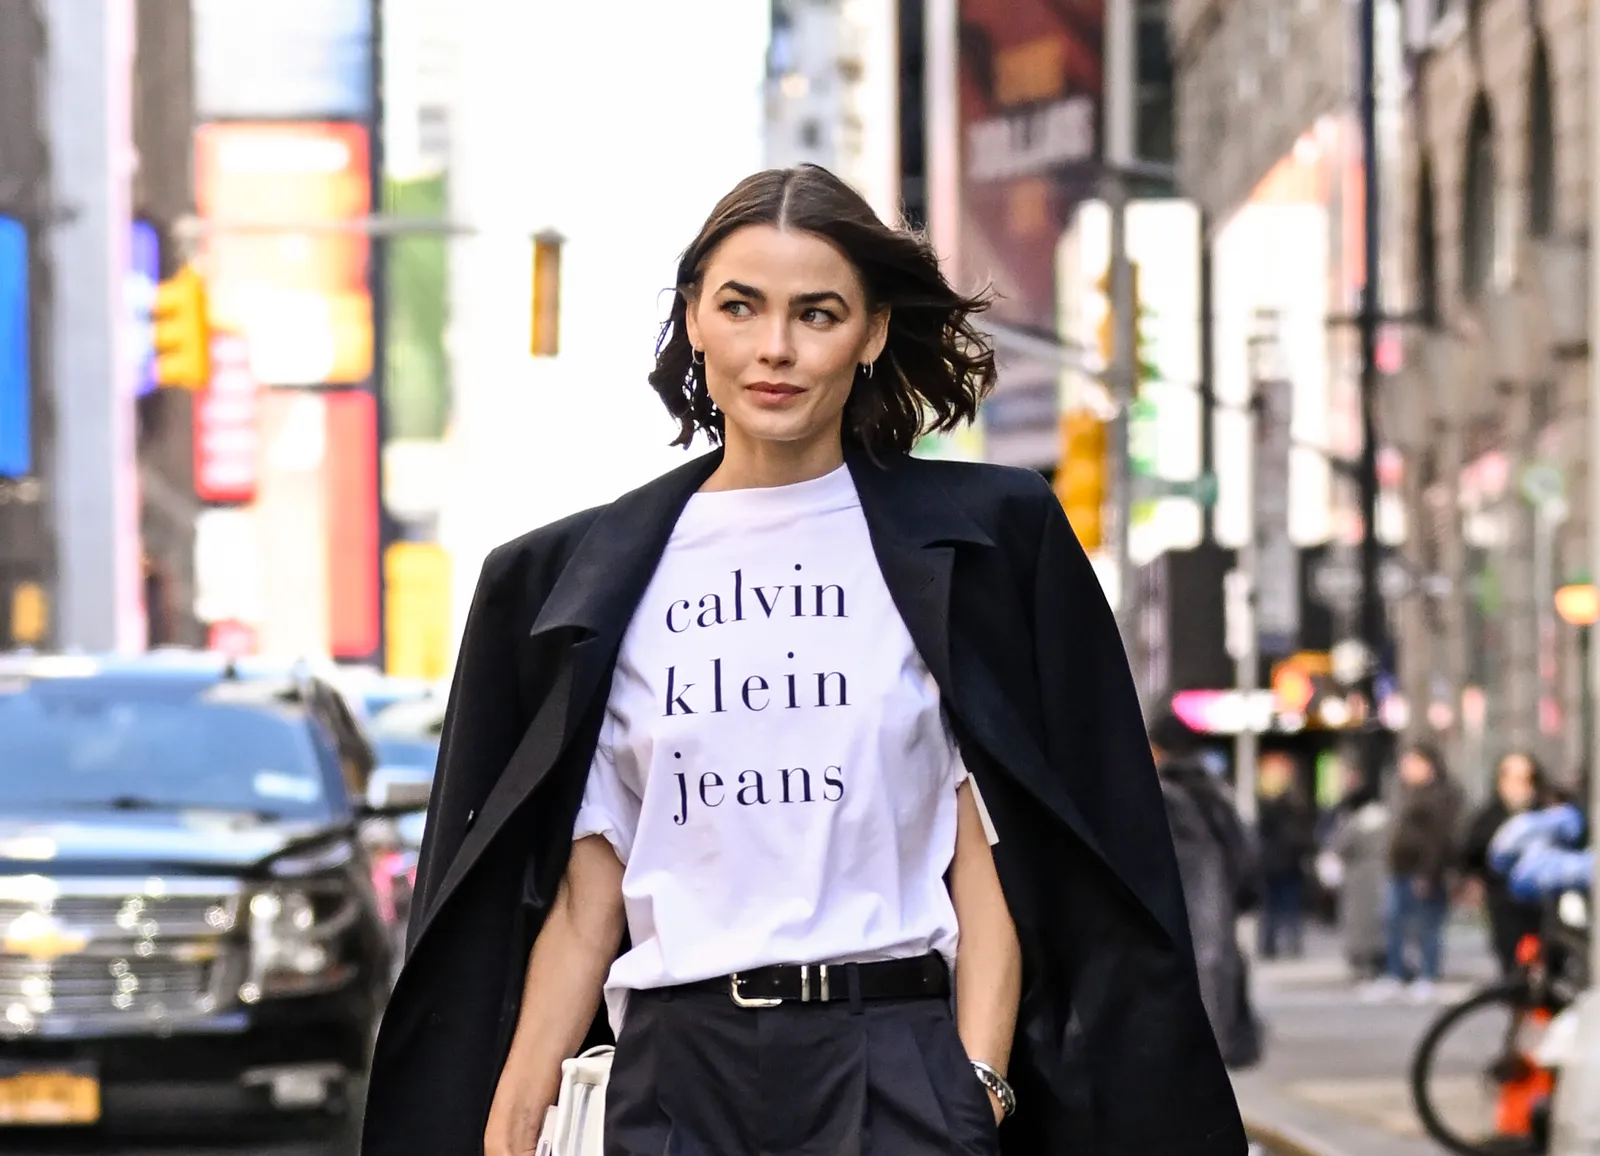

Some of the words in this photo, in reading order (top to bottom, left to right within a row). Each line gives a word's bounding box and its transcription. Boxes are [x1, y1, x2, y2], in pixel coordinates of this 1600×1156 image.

[666, 563, 849, 633] calvin
[662, 651, 851, 717] klein
[673, 751, 844, 826] jeans
